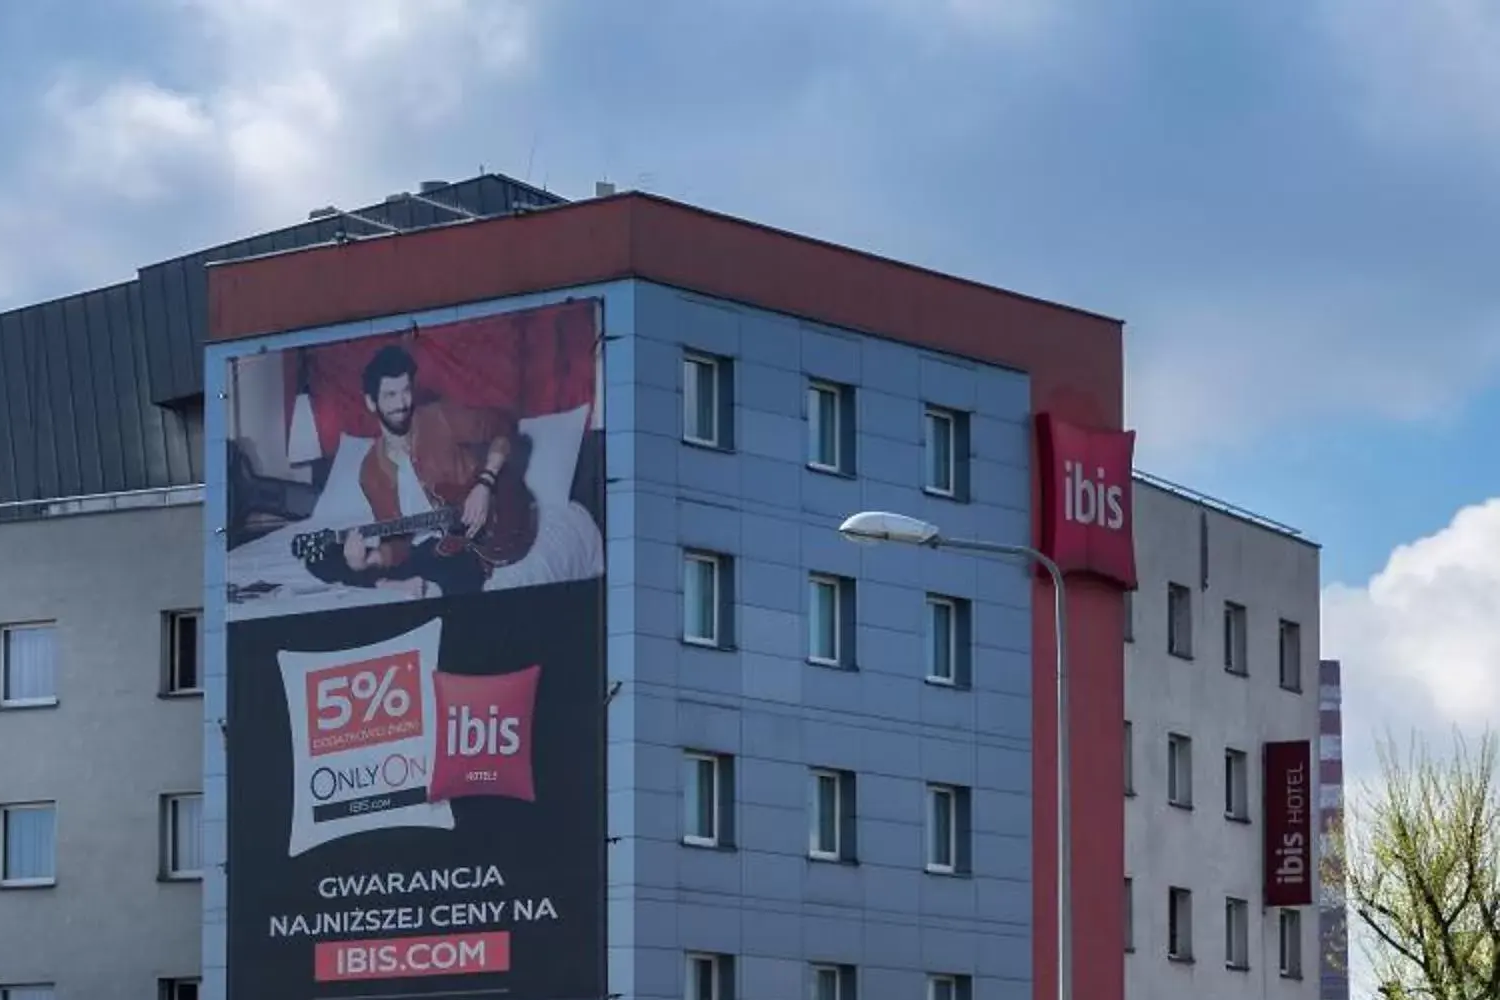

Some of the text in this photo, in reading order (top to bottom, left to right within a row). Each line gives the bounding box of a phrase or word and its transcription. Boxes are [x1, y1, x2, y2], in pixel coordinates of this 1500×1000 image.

[1063, 460, 1124, 530] ibis
[446, 705, 521, 758] ibis
[1276, 762, 1304, 884] ibis HOTEL
[318, 865, 506, 899] GWARANCJA
[269, 898, 559, 937] NAJNIŻSZEJ CENY NA
[336, 939, 487, 976] IBIS.COM
